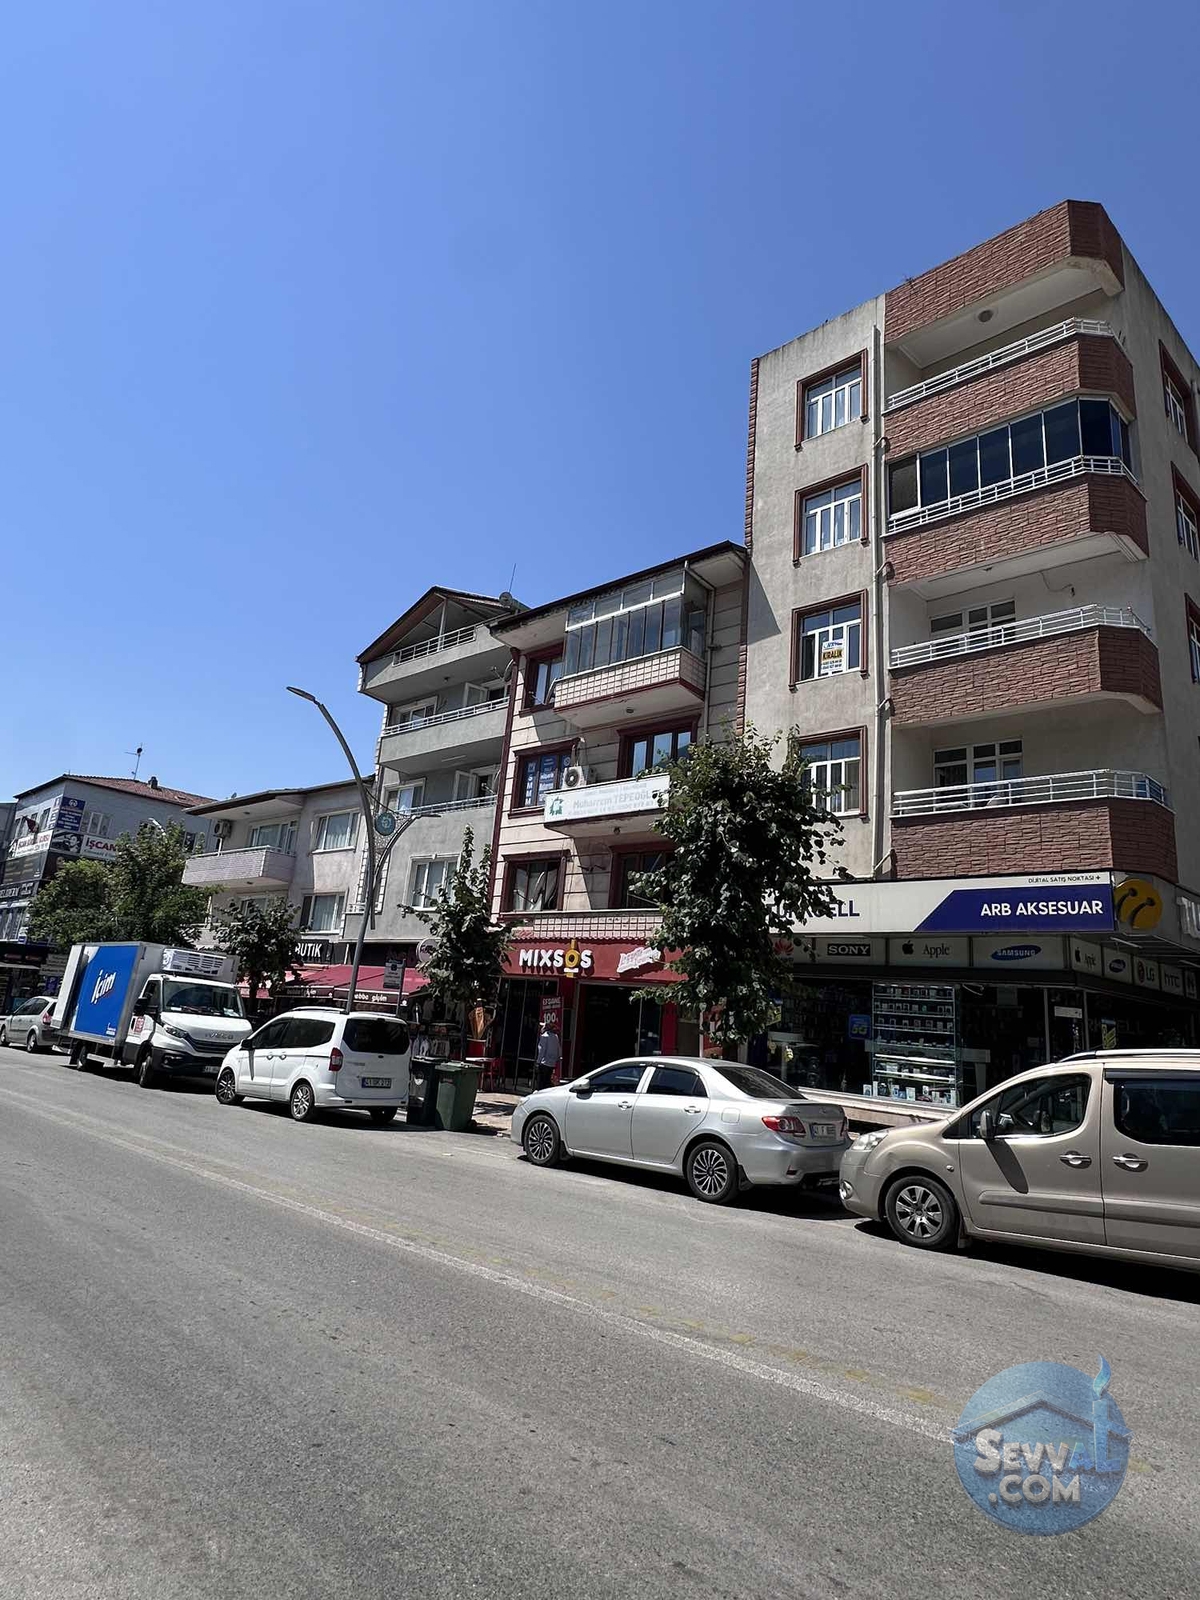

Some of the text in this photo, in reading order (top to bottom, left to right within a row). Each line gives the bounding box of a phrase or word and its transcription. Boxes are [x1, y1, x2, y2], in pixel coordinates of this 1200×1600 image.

[980, 900, 1104, 917] ARB AKSESUAR
[828, 945, 870, 955] SONY
[923, 943, 950, 958] Apple
[997, 949, 1036, 957] SAMSUNG
